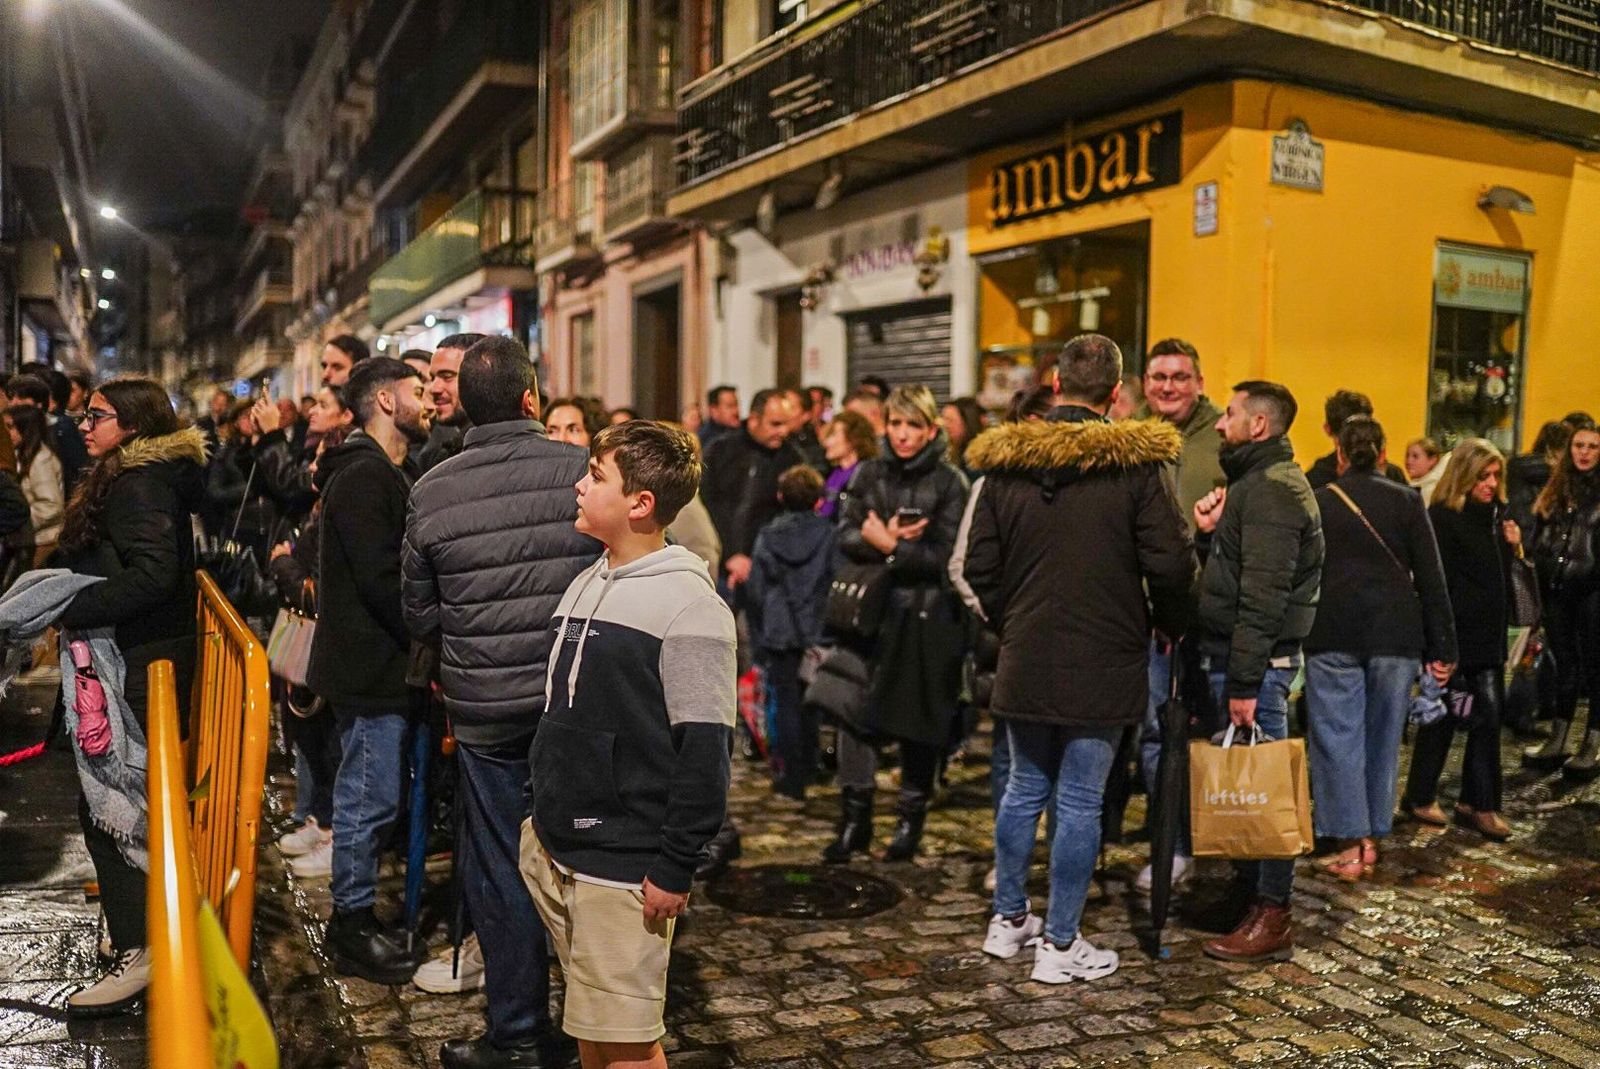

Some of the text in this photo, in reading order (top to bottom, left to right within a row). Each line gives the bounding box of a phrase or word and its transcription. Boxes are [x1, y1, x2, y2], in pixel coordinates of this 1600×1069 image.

[985, 119, 1163, 220] ambar
[1467, 267, 1521, 291] ambar
[1204, 788, 1268, 806] lefties
